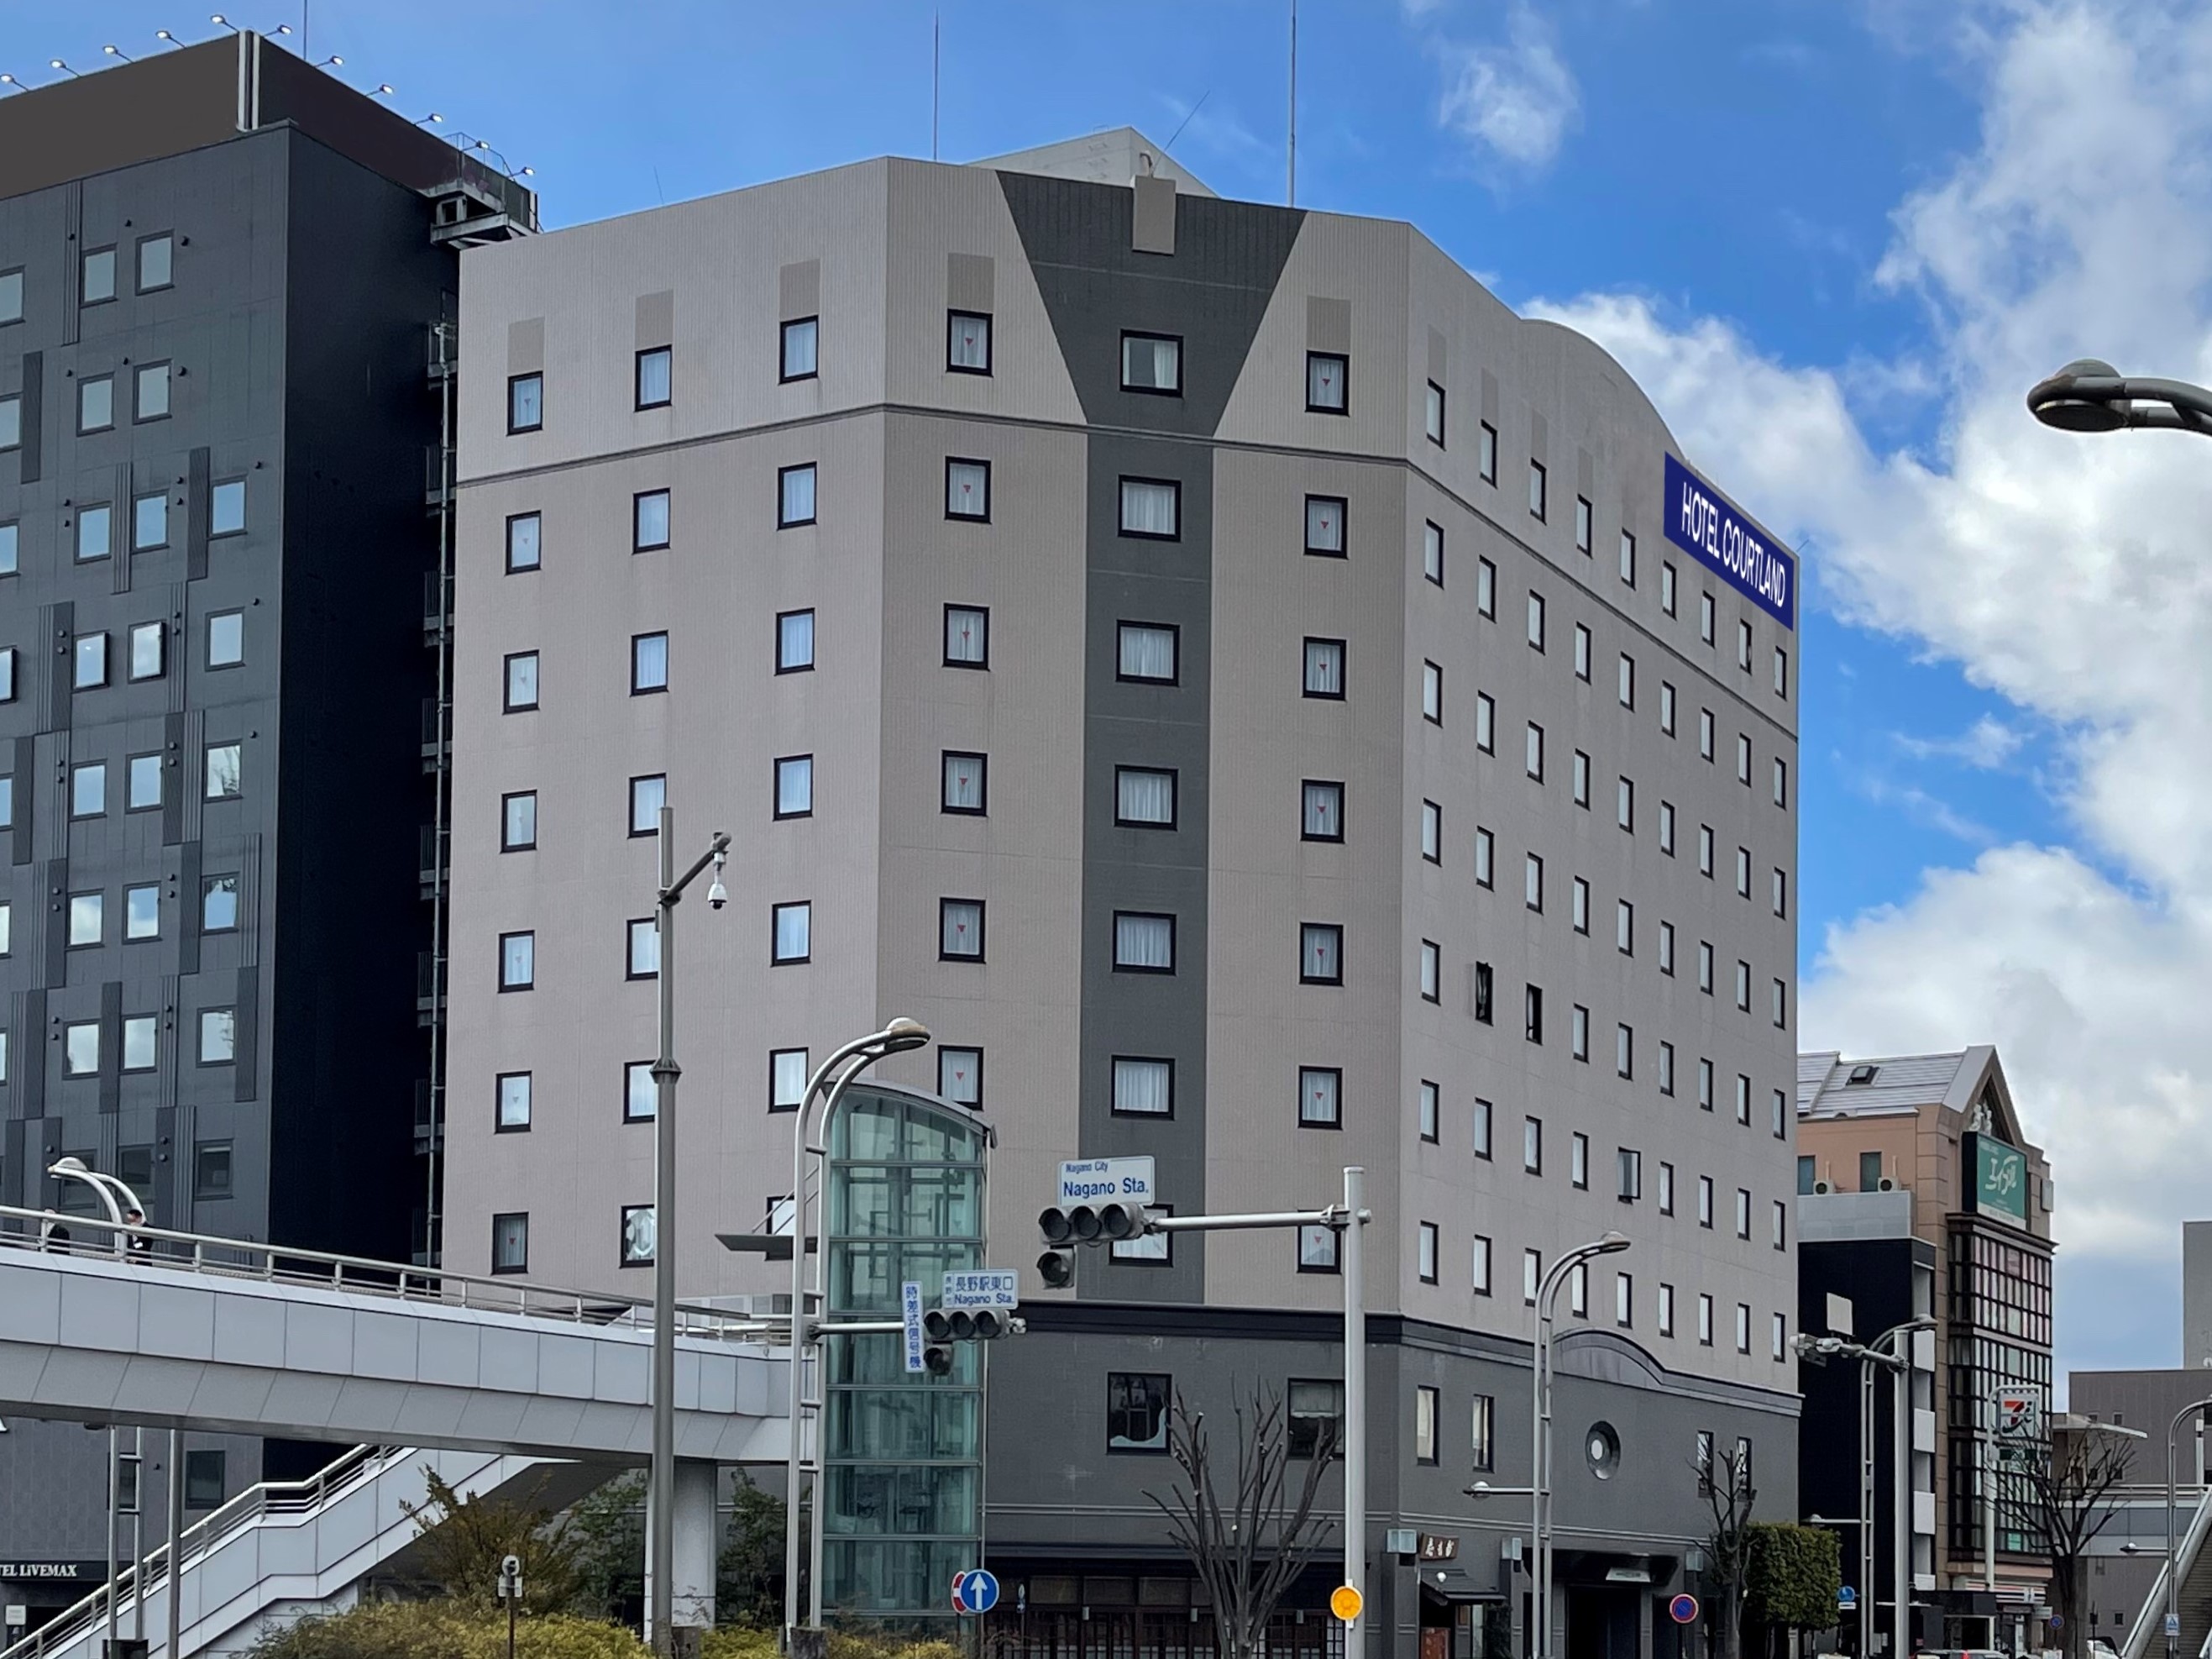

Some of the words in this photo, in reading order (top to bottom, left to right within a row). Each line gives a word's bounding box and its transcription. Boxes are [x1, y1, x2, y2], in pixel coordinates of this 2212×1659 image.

[1681, 481, 1720, 559] HOTEL
[1722, 517, 1786, 608] COURTLAND
[1066, 1163, 1092, 1175] Nagano
[1094, 1161, 1109, 1173] City
[1063, 1181, 1115, 1200] Nagano
[1122, 1177, 1149, 1194] Sta.
[955, 1275, 1014, 1292] 長野駅東口
[954, 1294, 991, 1307] Nagano
[996, 1292, 1014, 1304] Sta.
[906, 1286, 921, 1368] 時差式信号機
